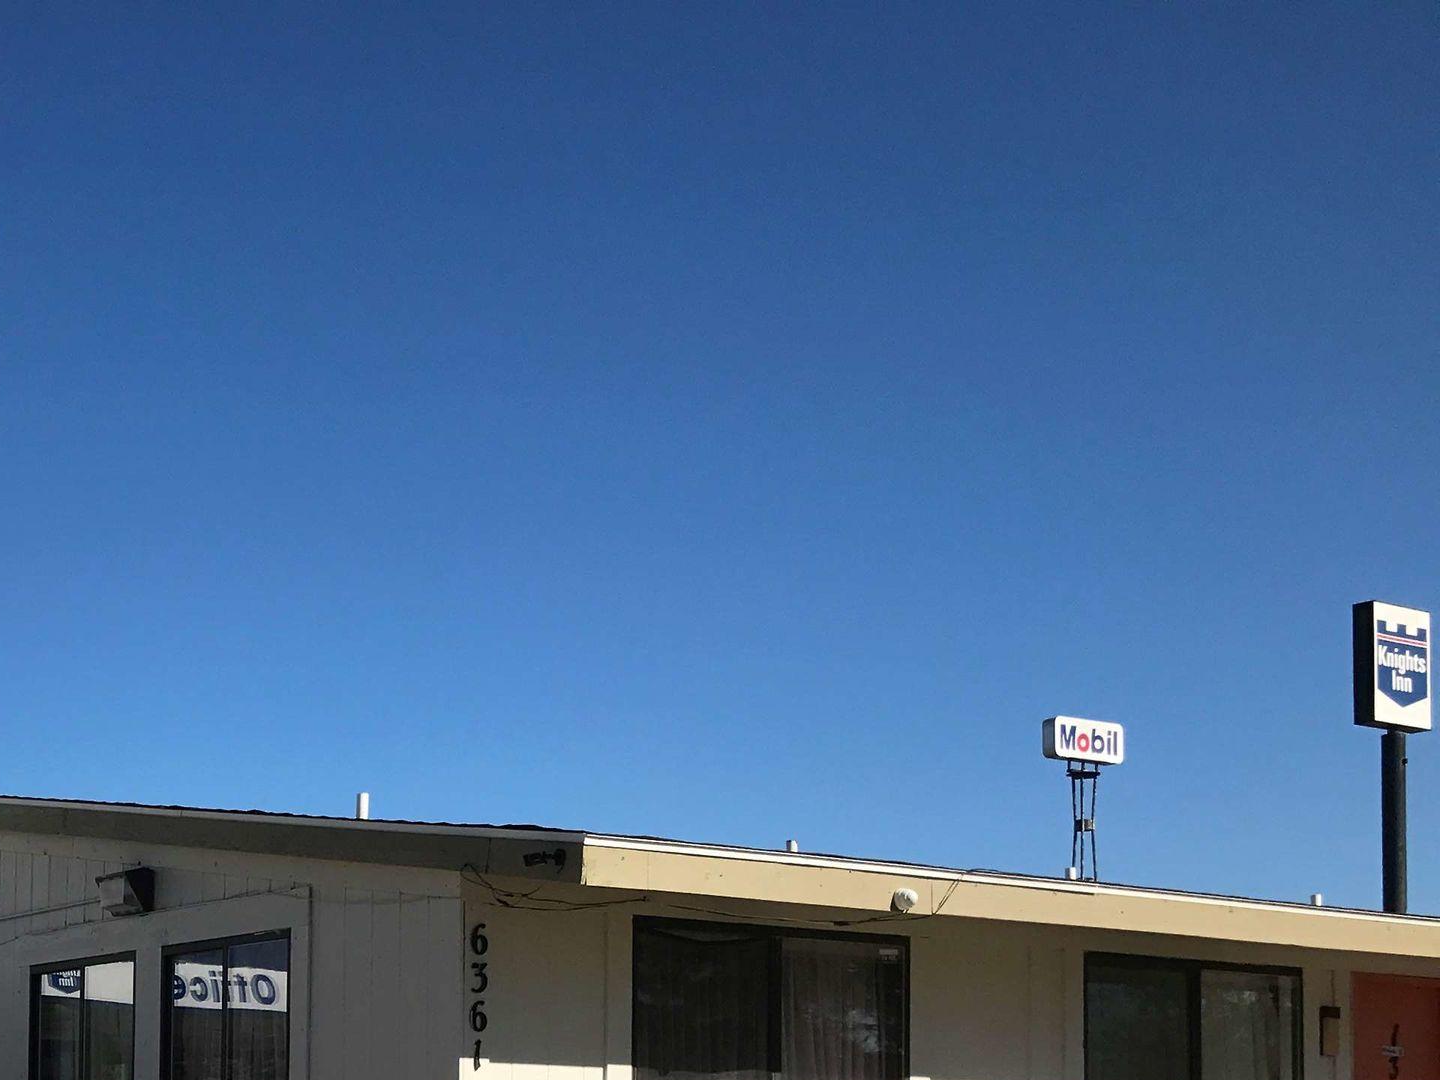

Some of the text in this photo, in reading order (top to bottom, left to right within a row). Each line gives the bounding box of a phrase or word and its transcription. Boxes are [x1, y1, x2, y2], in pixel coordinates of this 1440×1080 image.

[1378, 645, 1426, 674] Knights
[1392, 669, 1413, 693] Inn
[1060, 724, 1118, 756] Mobil
[470, 923, 488, 1072] 6361
